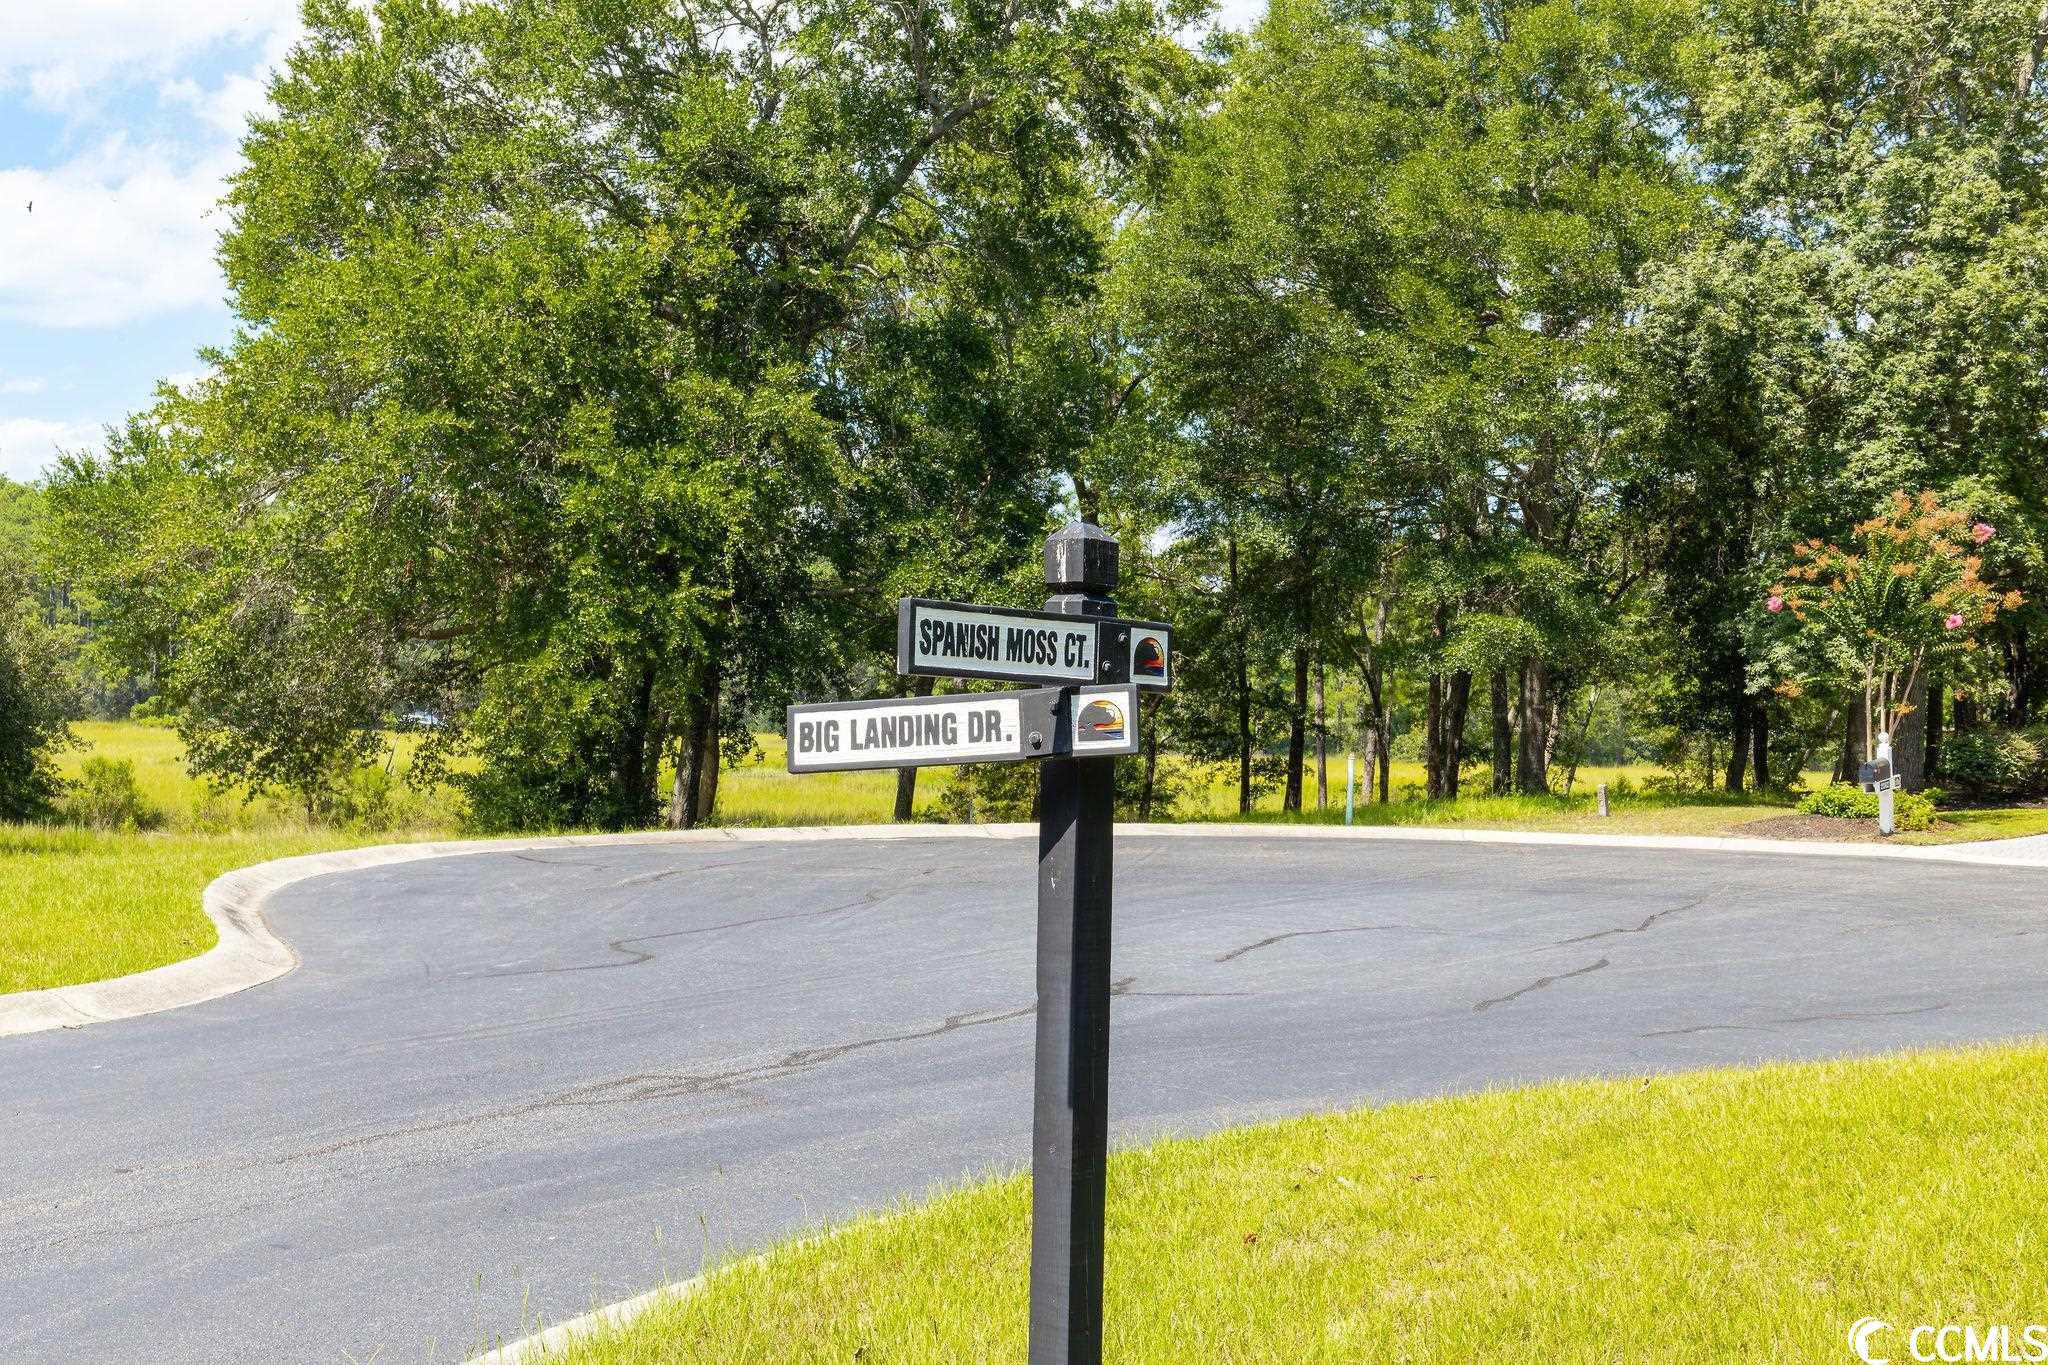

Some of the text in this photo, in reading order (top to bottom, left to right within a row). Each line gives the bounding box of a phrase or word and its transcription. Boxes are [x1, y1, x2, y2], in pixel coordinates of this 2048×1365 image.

[919, 618, 1090, 669] SPANISH MOSS CT.
[799, 709, 1013, 753] BIG LANDING DR.
